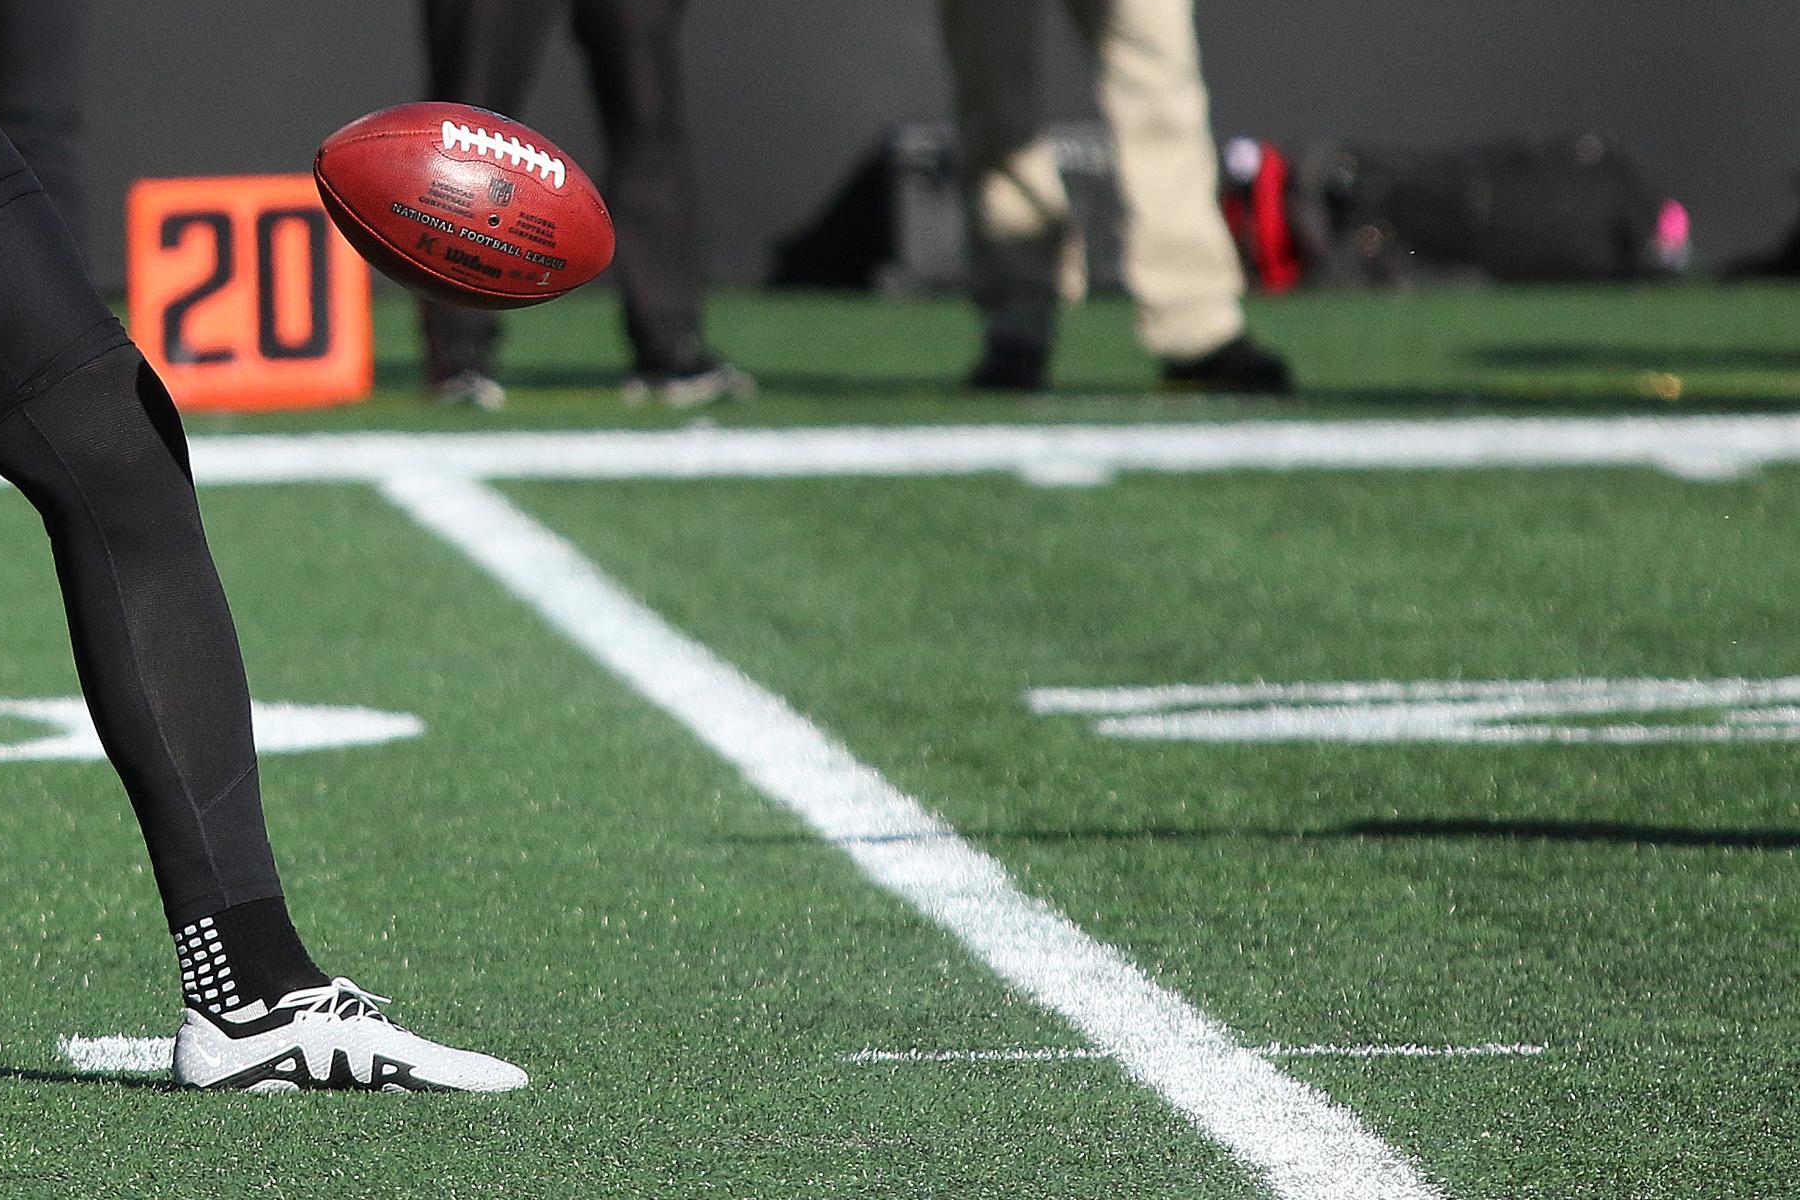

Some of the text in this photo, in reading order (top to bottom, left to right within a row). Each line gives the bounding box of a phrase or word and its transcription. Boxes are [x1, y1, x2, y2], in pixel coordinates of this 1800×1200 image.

[159, 206, 330, 364] 20
[391, 202, 567, 270] NATIONAL FOOTBALL LEAGUE
